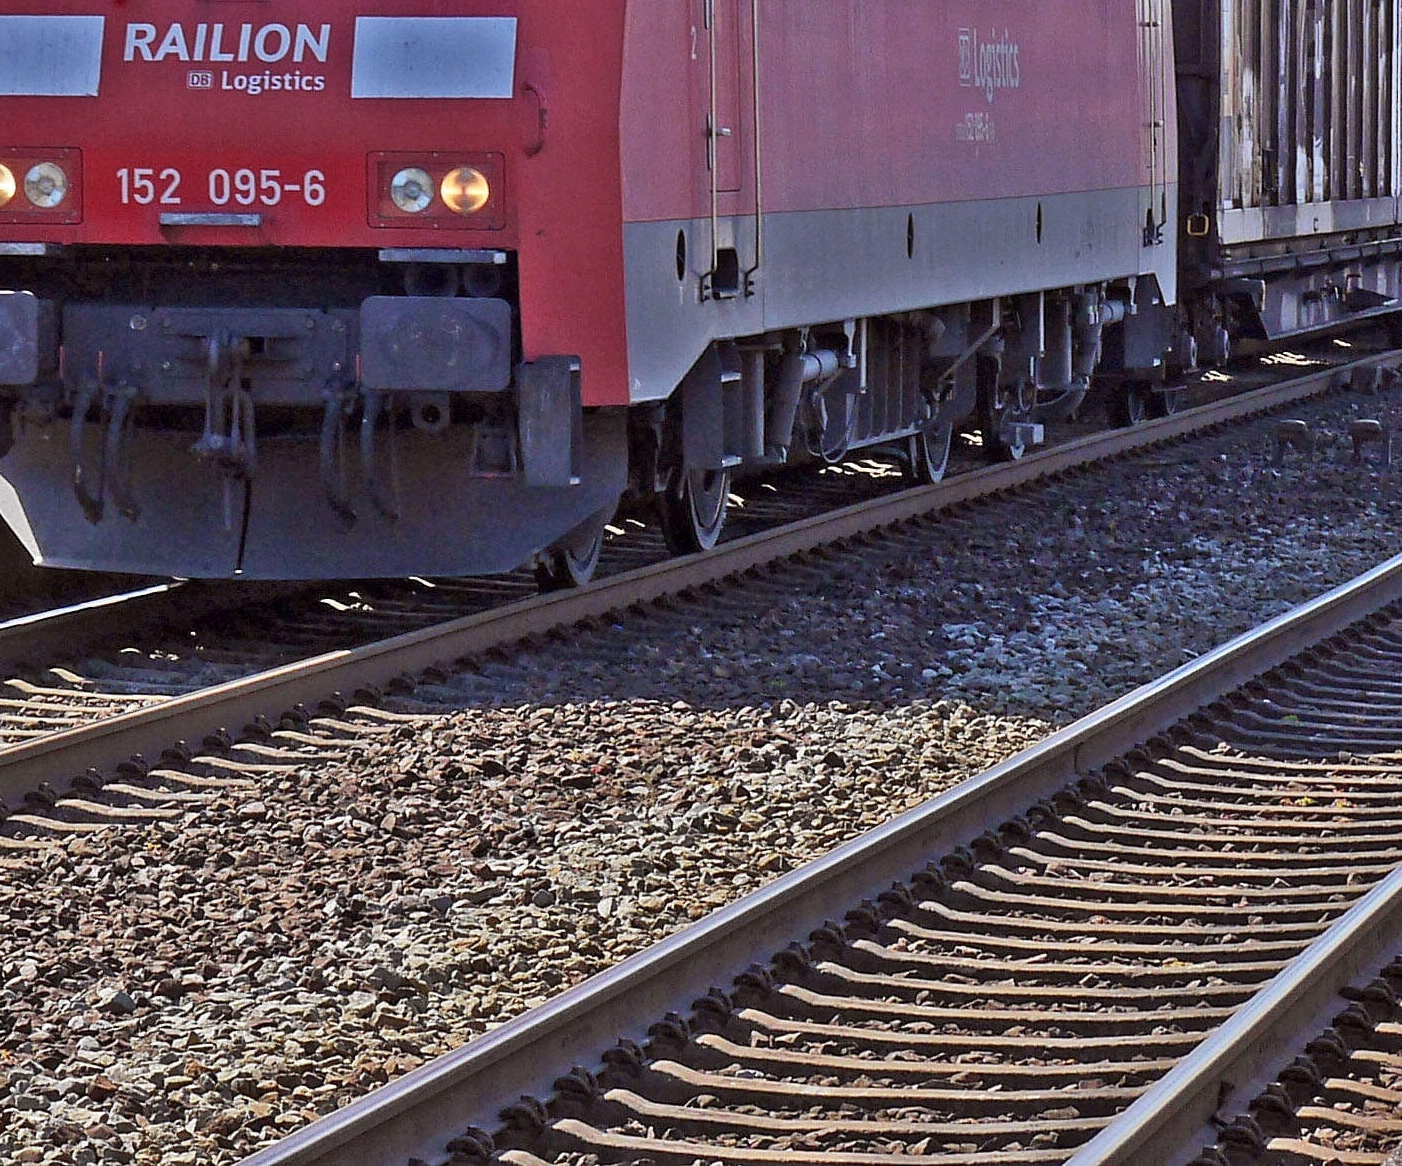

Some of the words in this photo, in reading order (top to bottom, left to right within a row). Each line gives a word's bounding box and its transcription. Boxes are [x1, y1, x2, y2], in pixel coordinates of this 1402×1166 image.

[123, 23, 331, 63] RAILION
[690, 25, 697, 60] 2
[188, 71, 212, 89] DB
[221, 70, 325, 95] Logistics
[973, 27, 1020, 102] Logistics
[116, 168, 181, 204] 152
[208, 169, 326, 206] 095-6
